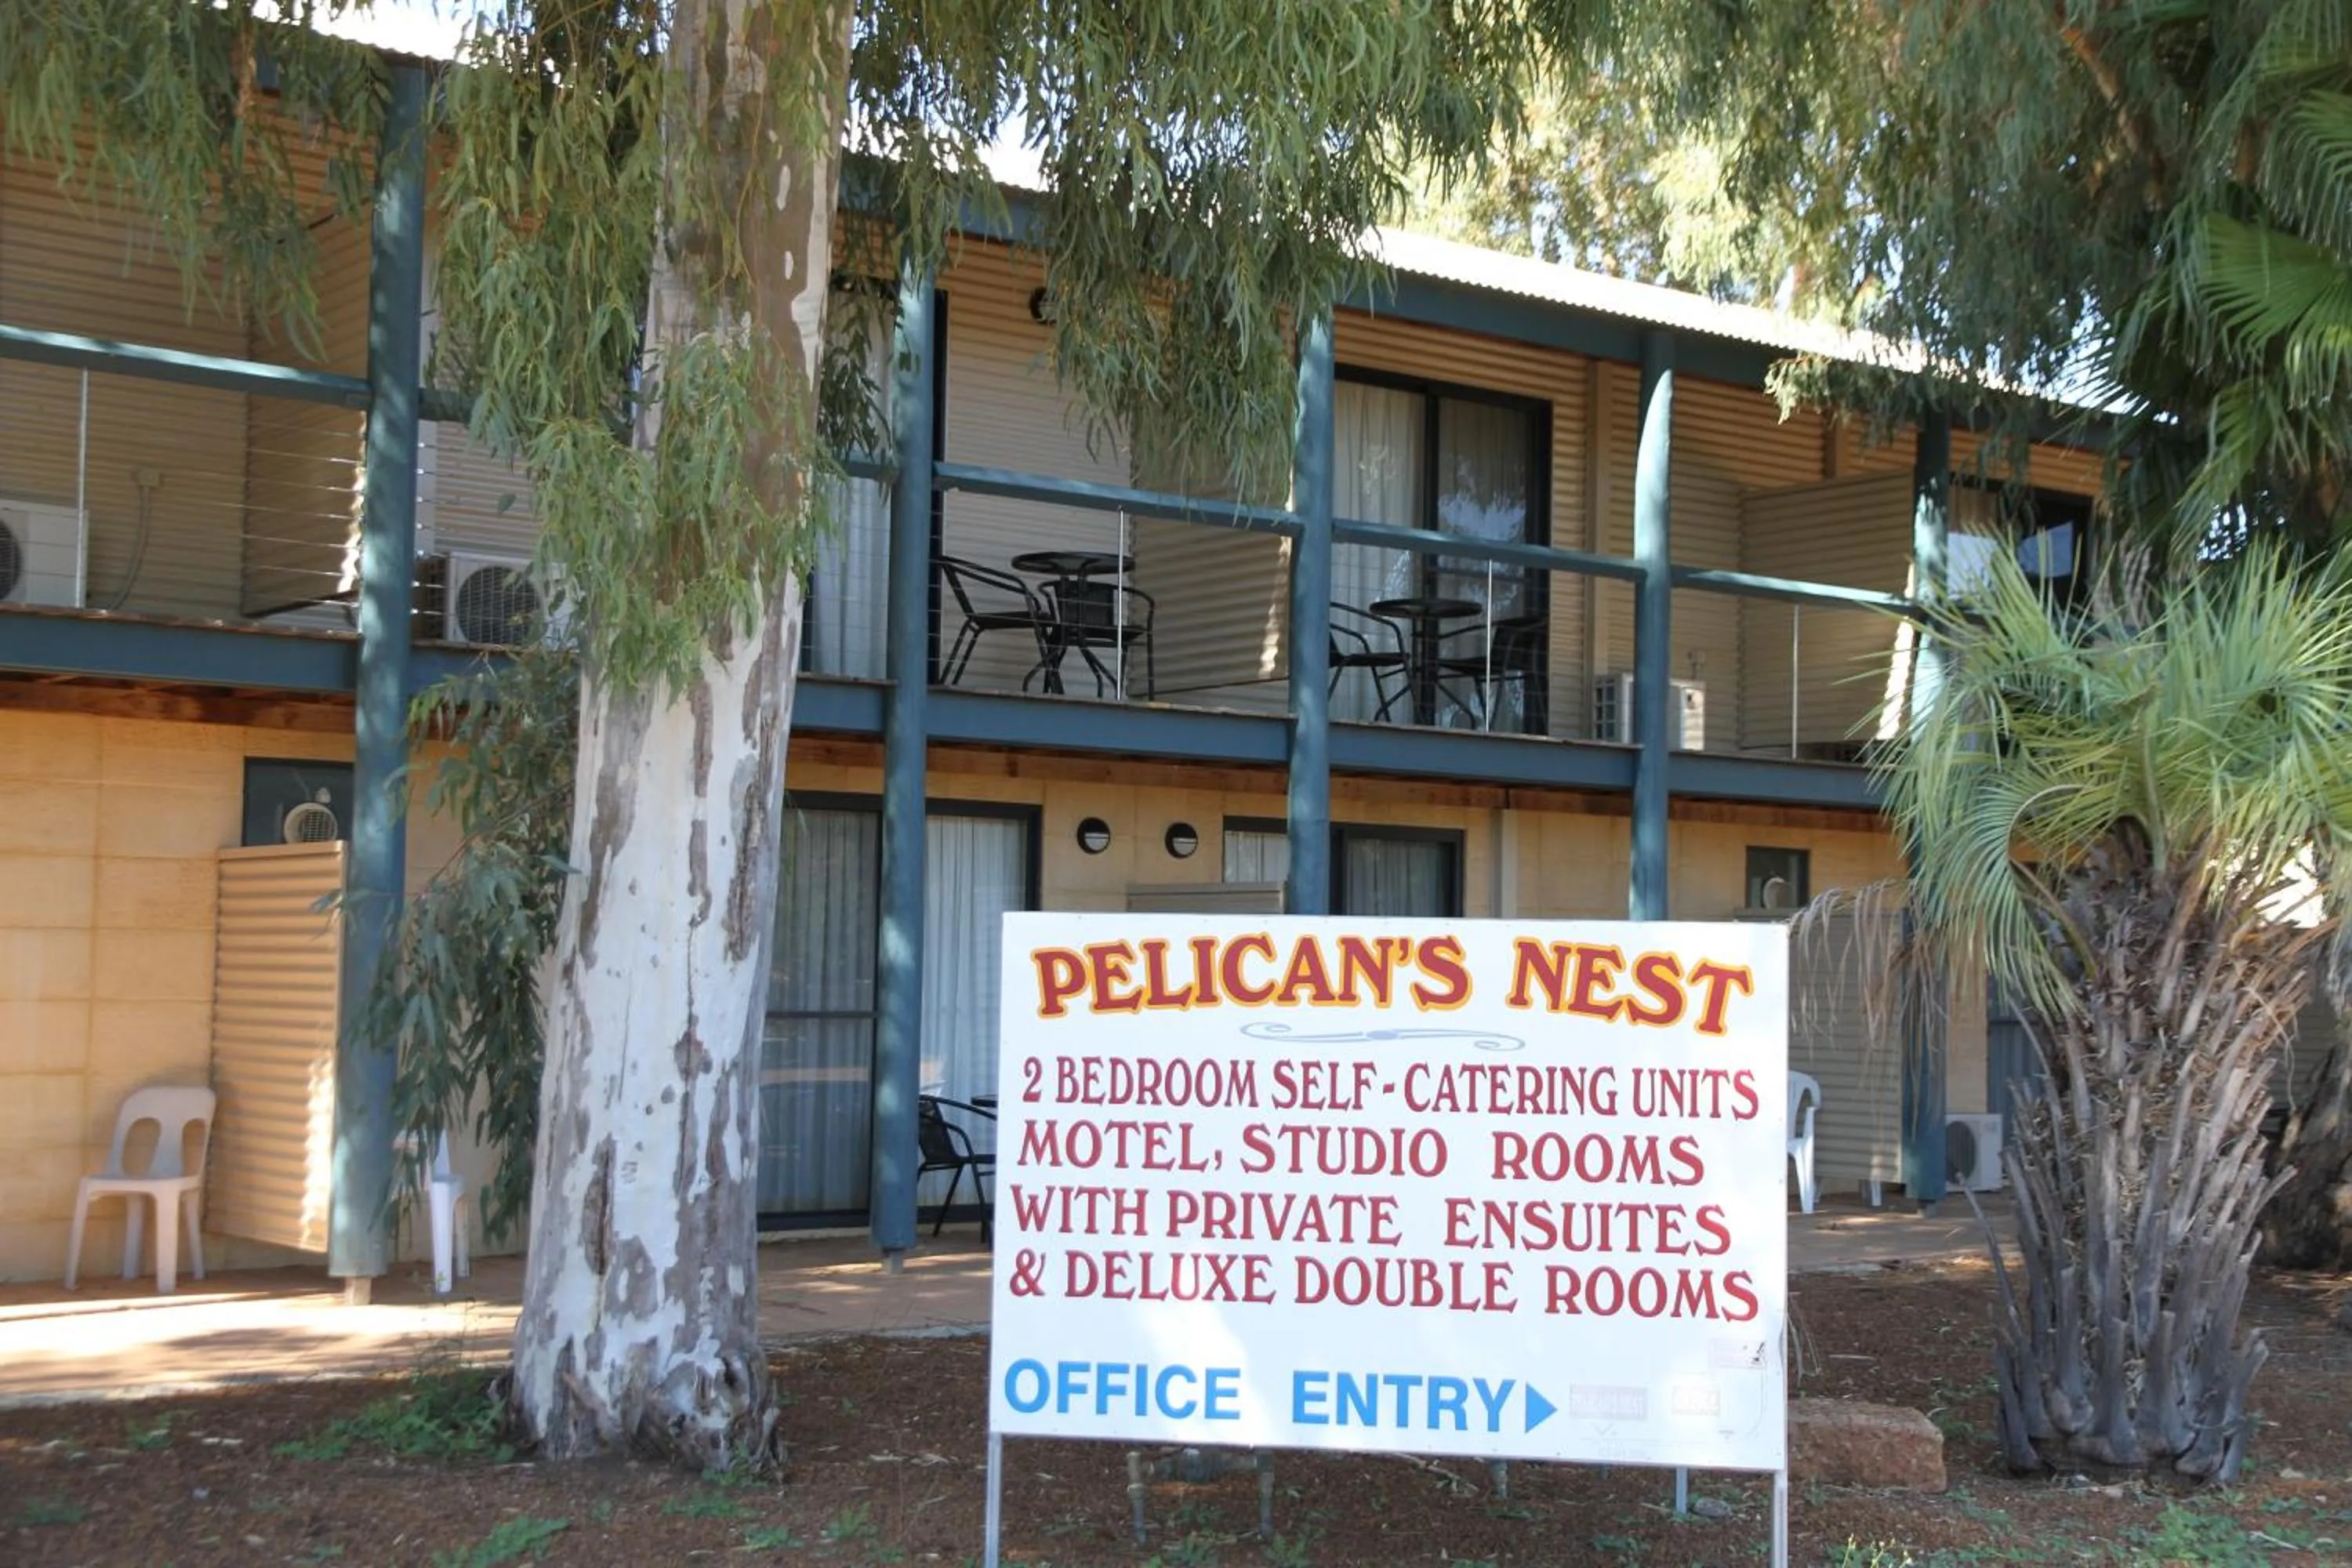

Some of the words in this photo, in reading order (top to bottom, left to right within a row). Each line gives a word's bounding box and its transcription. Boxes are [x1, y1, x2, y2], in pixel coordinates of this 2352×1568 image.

[1031, 932, 1474, 1019] PELICAN'S
[1505, 937, 1755, 1036] NEST
[1022, 1057, 1044, 1103] 2
[1057, 1056, 1257, 1107] BEDROOM
[1632, 1068, 1759, 1121] UNITS
[1017, 1120, 1222, 1172] MOTEL,
[1240, 1125, 1447, 1178] STUDIO
[1493, 1131, 1705, 1186] ROOMS
[1011, 1185, 1148, 1237] WITH
[1167, 1189, 1402, 1247] PRIVATE
[1445, 1198, 1731, 1256] ENSUITES
[1009, 1248, 1045, 1298] &
[1065, 1250, 1276, 1305] DELUXE
[1294, 1256, 1517, 1312] DOUBLE
[1545, 1265, 1759, 1322] ROOMS
[1003, 1357, 1241, 1421] OFFICE
[1291, 1370, 1517, 1434] ENTRY
